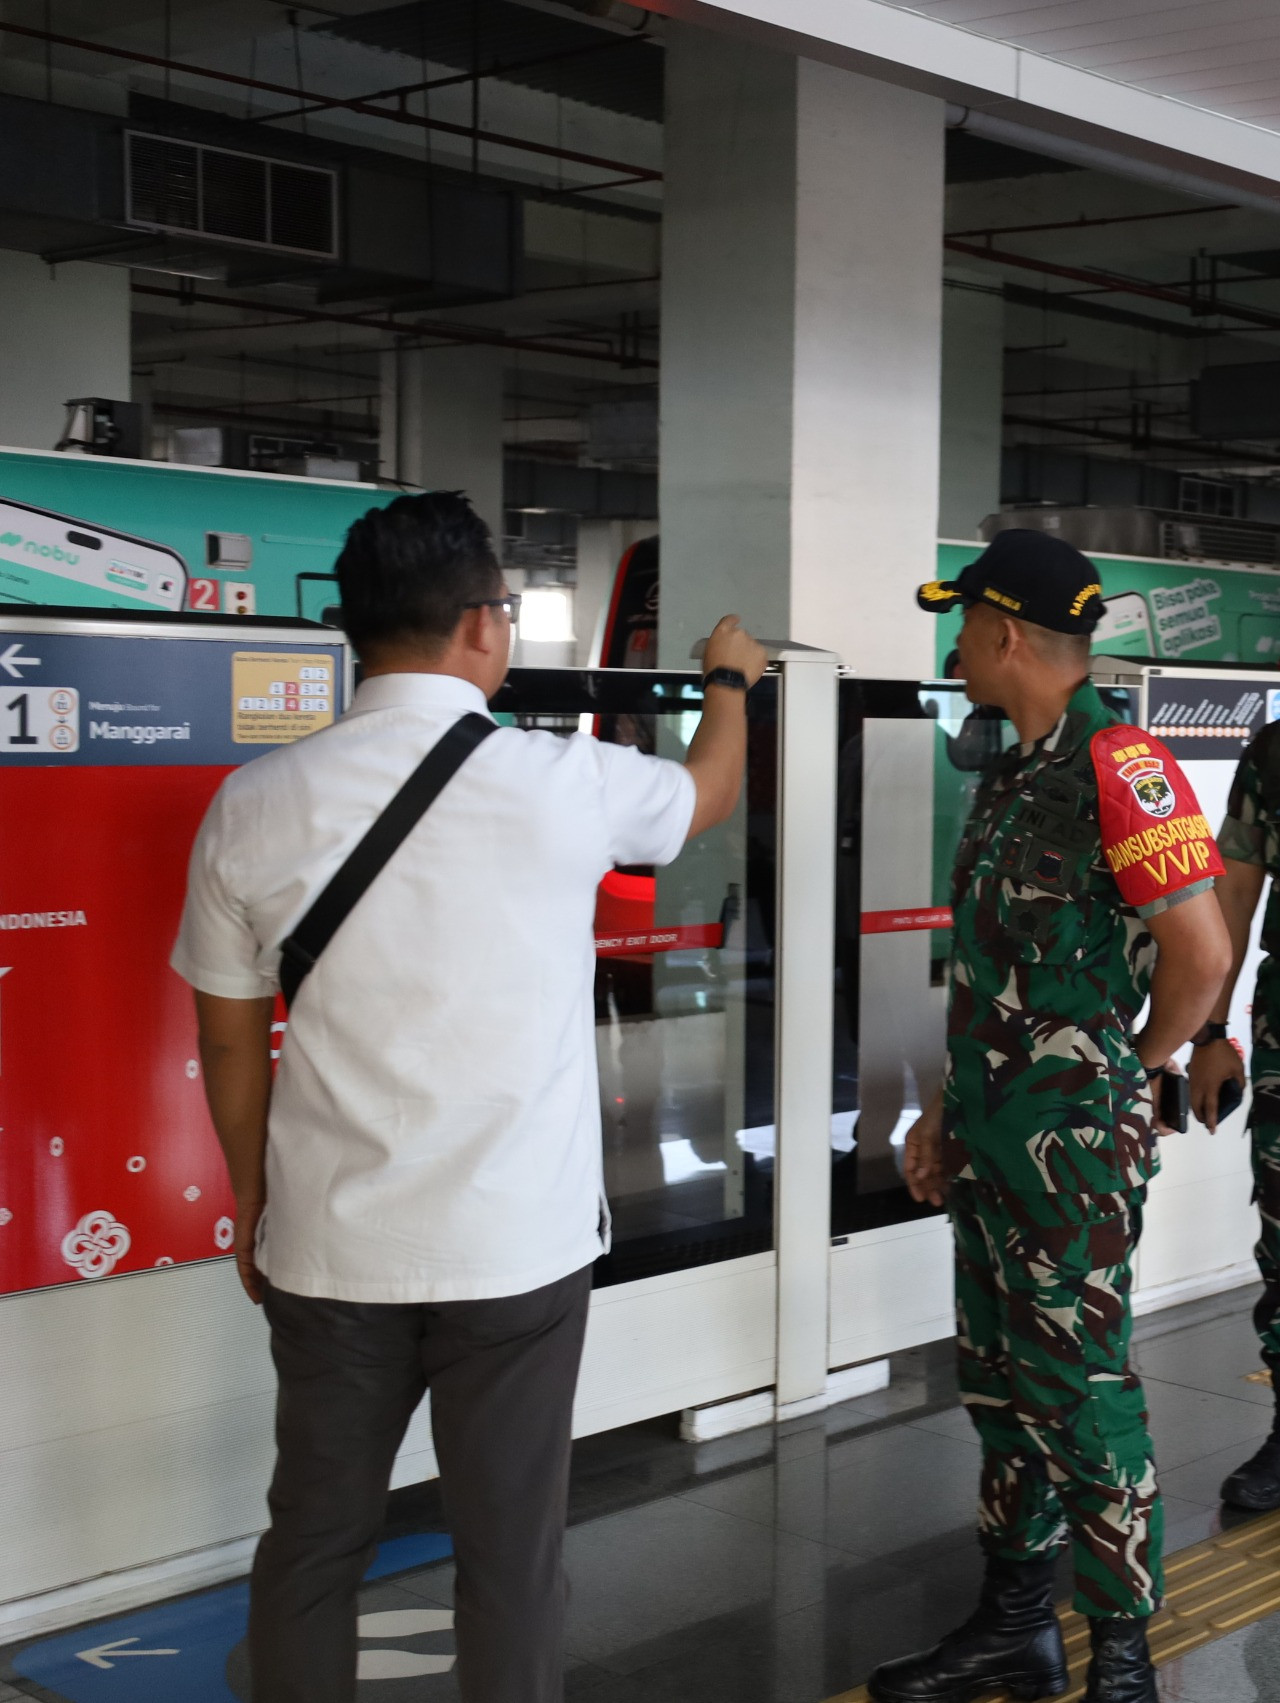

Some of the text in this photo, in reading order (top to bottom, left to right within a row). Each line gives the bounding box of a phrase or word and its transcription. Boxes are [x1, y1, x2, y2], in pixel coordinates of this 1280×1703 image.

[24, 540, 80, 566] nobu
[193, 580, 216, 610] 2
[1153, 591, 1186, 611] Bisa
[1158, 606, 1208, 632] semua
[1162, 623, 1219, 653] aplikasi
[6, 693, 39, 745] 1
[89, 720, 192, 745] Manggarai
[1142, 840, 1210, 886] VVIP
[625, 935, 648, 946] EXIT
[649, 933, 679, 944] DOOR
